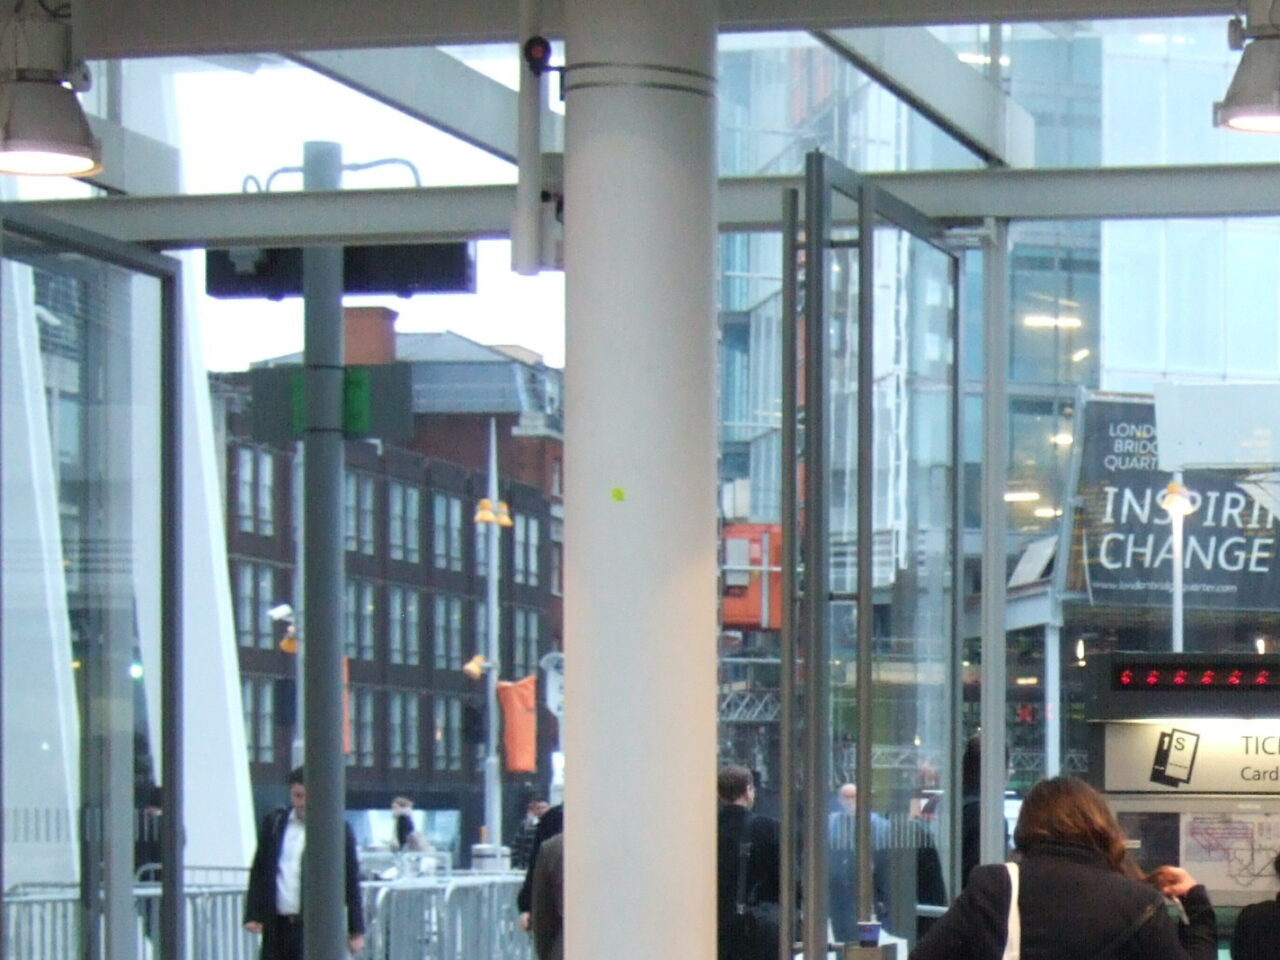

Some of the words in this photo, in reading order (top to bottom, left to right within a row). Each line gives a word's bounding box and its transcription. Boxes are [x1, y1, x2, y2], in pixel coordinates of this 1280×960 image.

[1109, 423, 1157, 438] LOND
[1104, 455, 1159, 472] QUART
[1099, 532, 1275, 573] CHANGE
[1092, 580, 1238, 594] www.londonbridgquarter.com
[1240, 766, 1279, 782] Card
